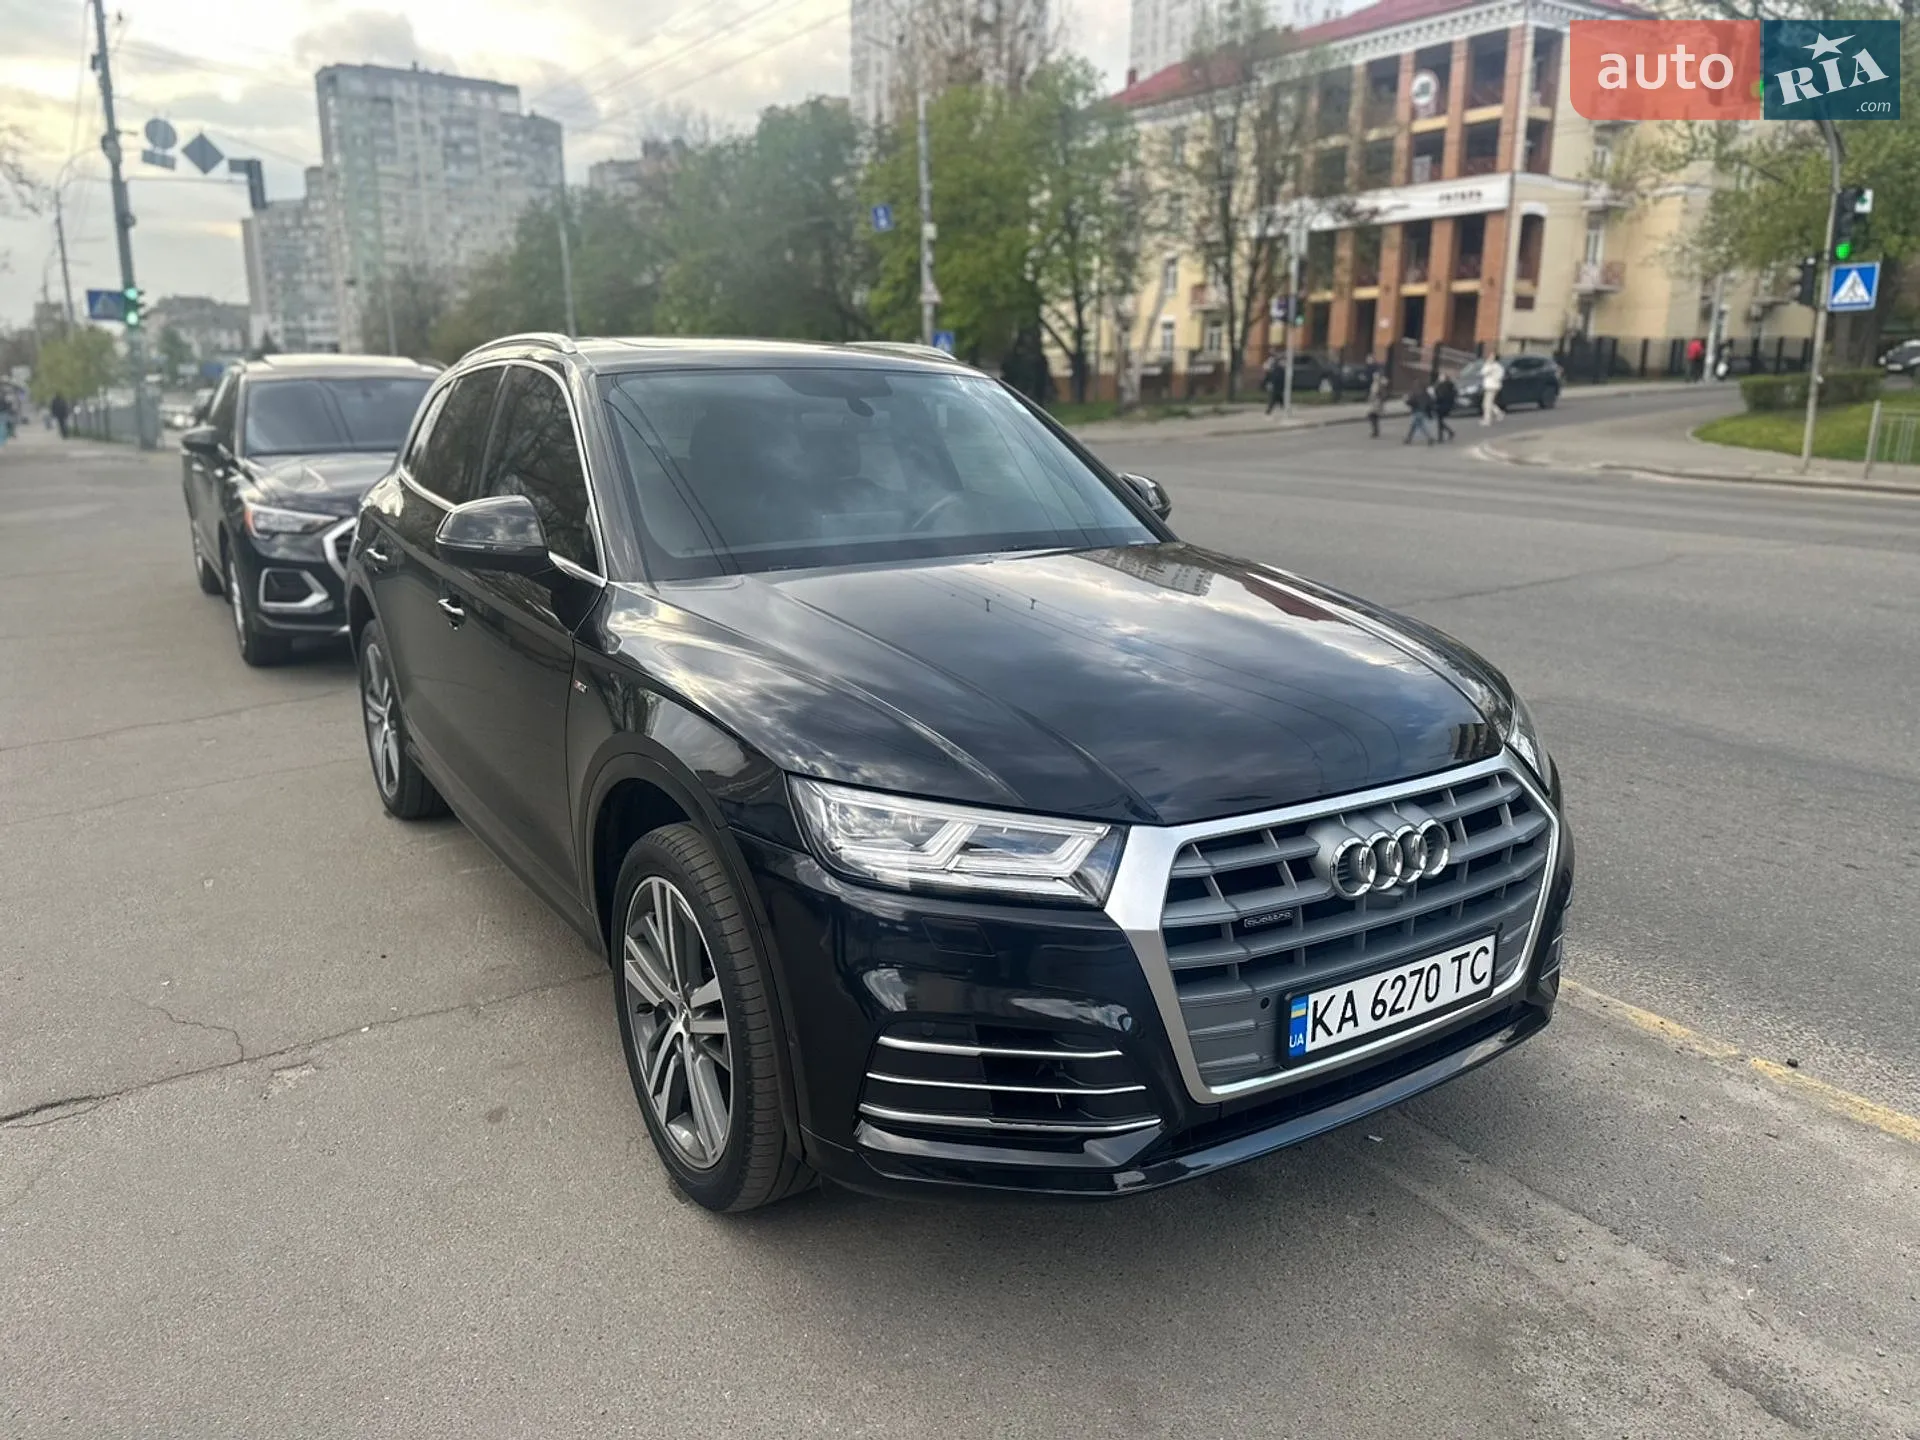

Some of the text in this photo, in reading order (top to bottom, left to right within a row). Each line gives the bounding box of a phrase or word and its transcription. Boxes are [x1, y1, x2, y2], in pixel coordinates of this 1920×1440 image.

[1310, 946, 1489, 1042] KA 6270 TC
[1289, 1035, 1304, 1048] UA
